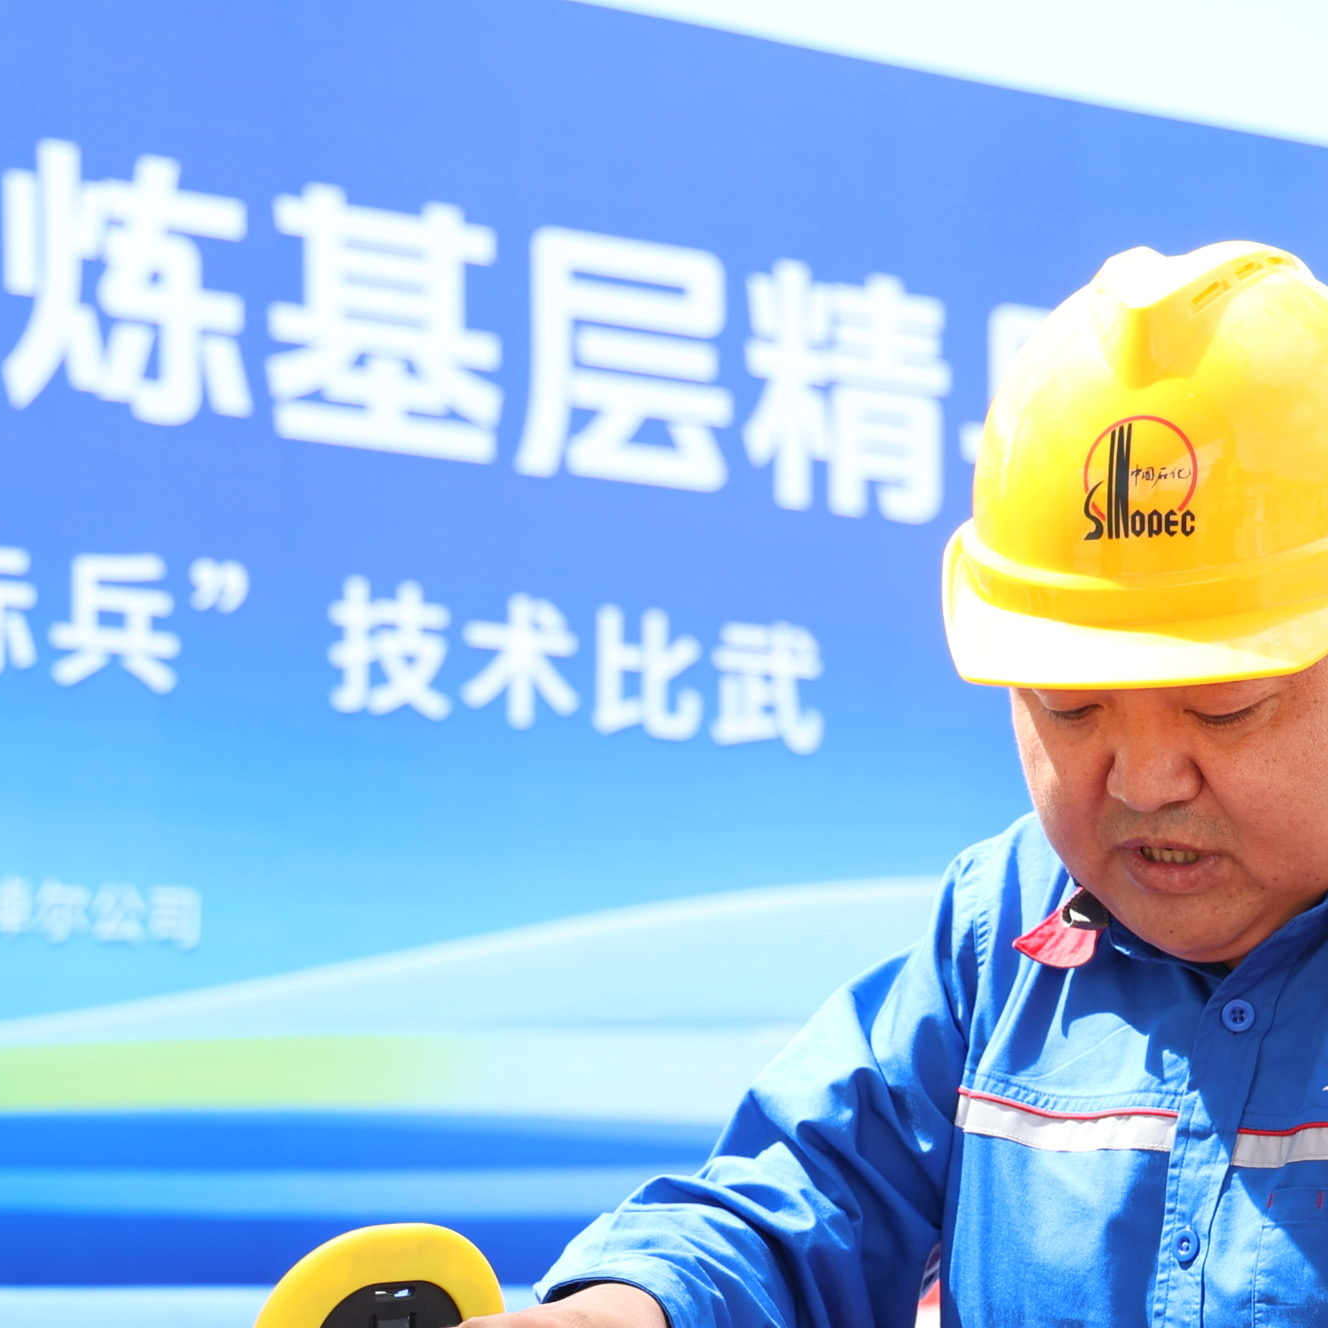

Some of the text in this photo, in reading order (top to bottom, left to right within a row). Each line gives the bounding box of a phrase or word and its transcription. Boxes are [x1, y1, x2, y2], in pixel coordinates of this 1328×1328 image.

[1083, 422, 1196, 541] SINOPEC
[329, 577, 825, 755] 技术比武
